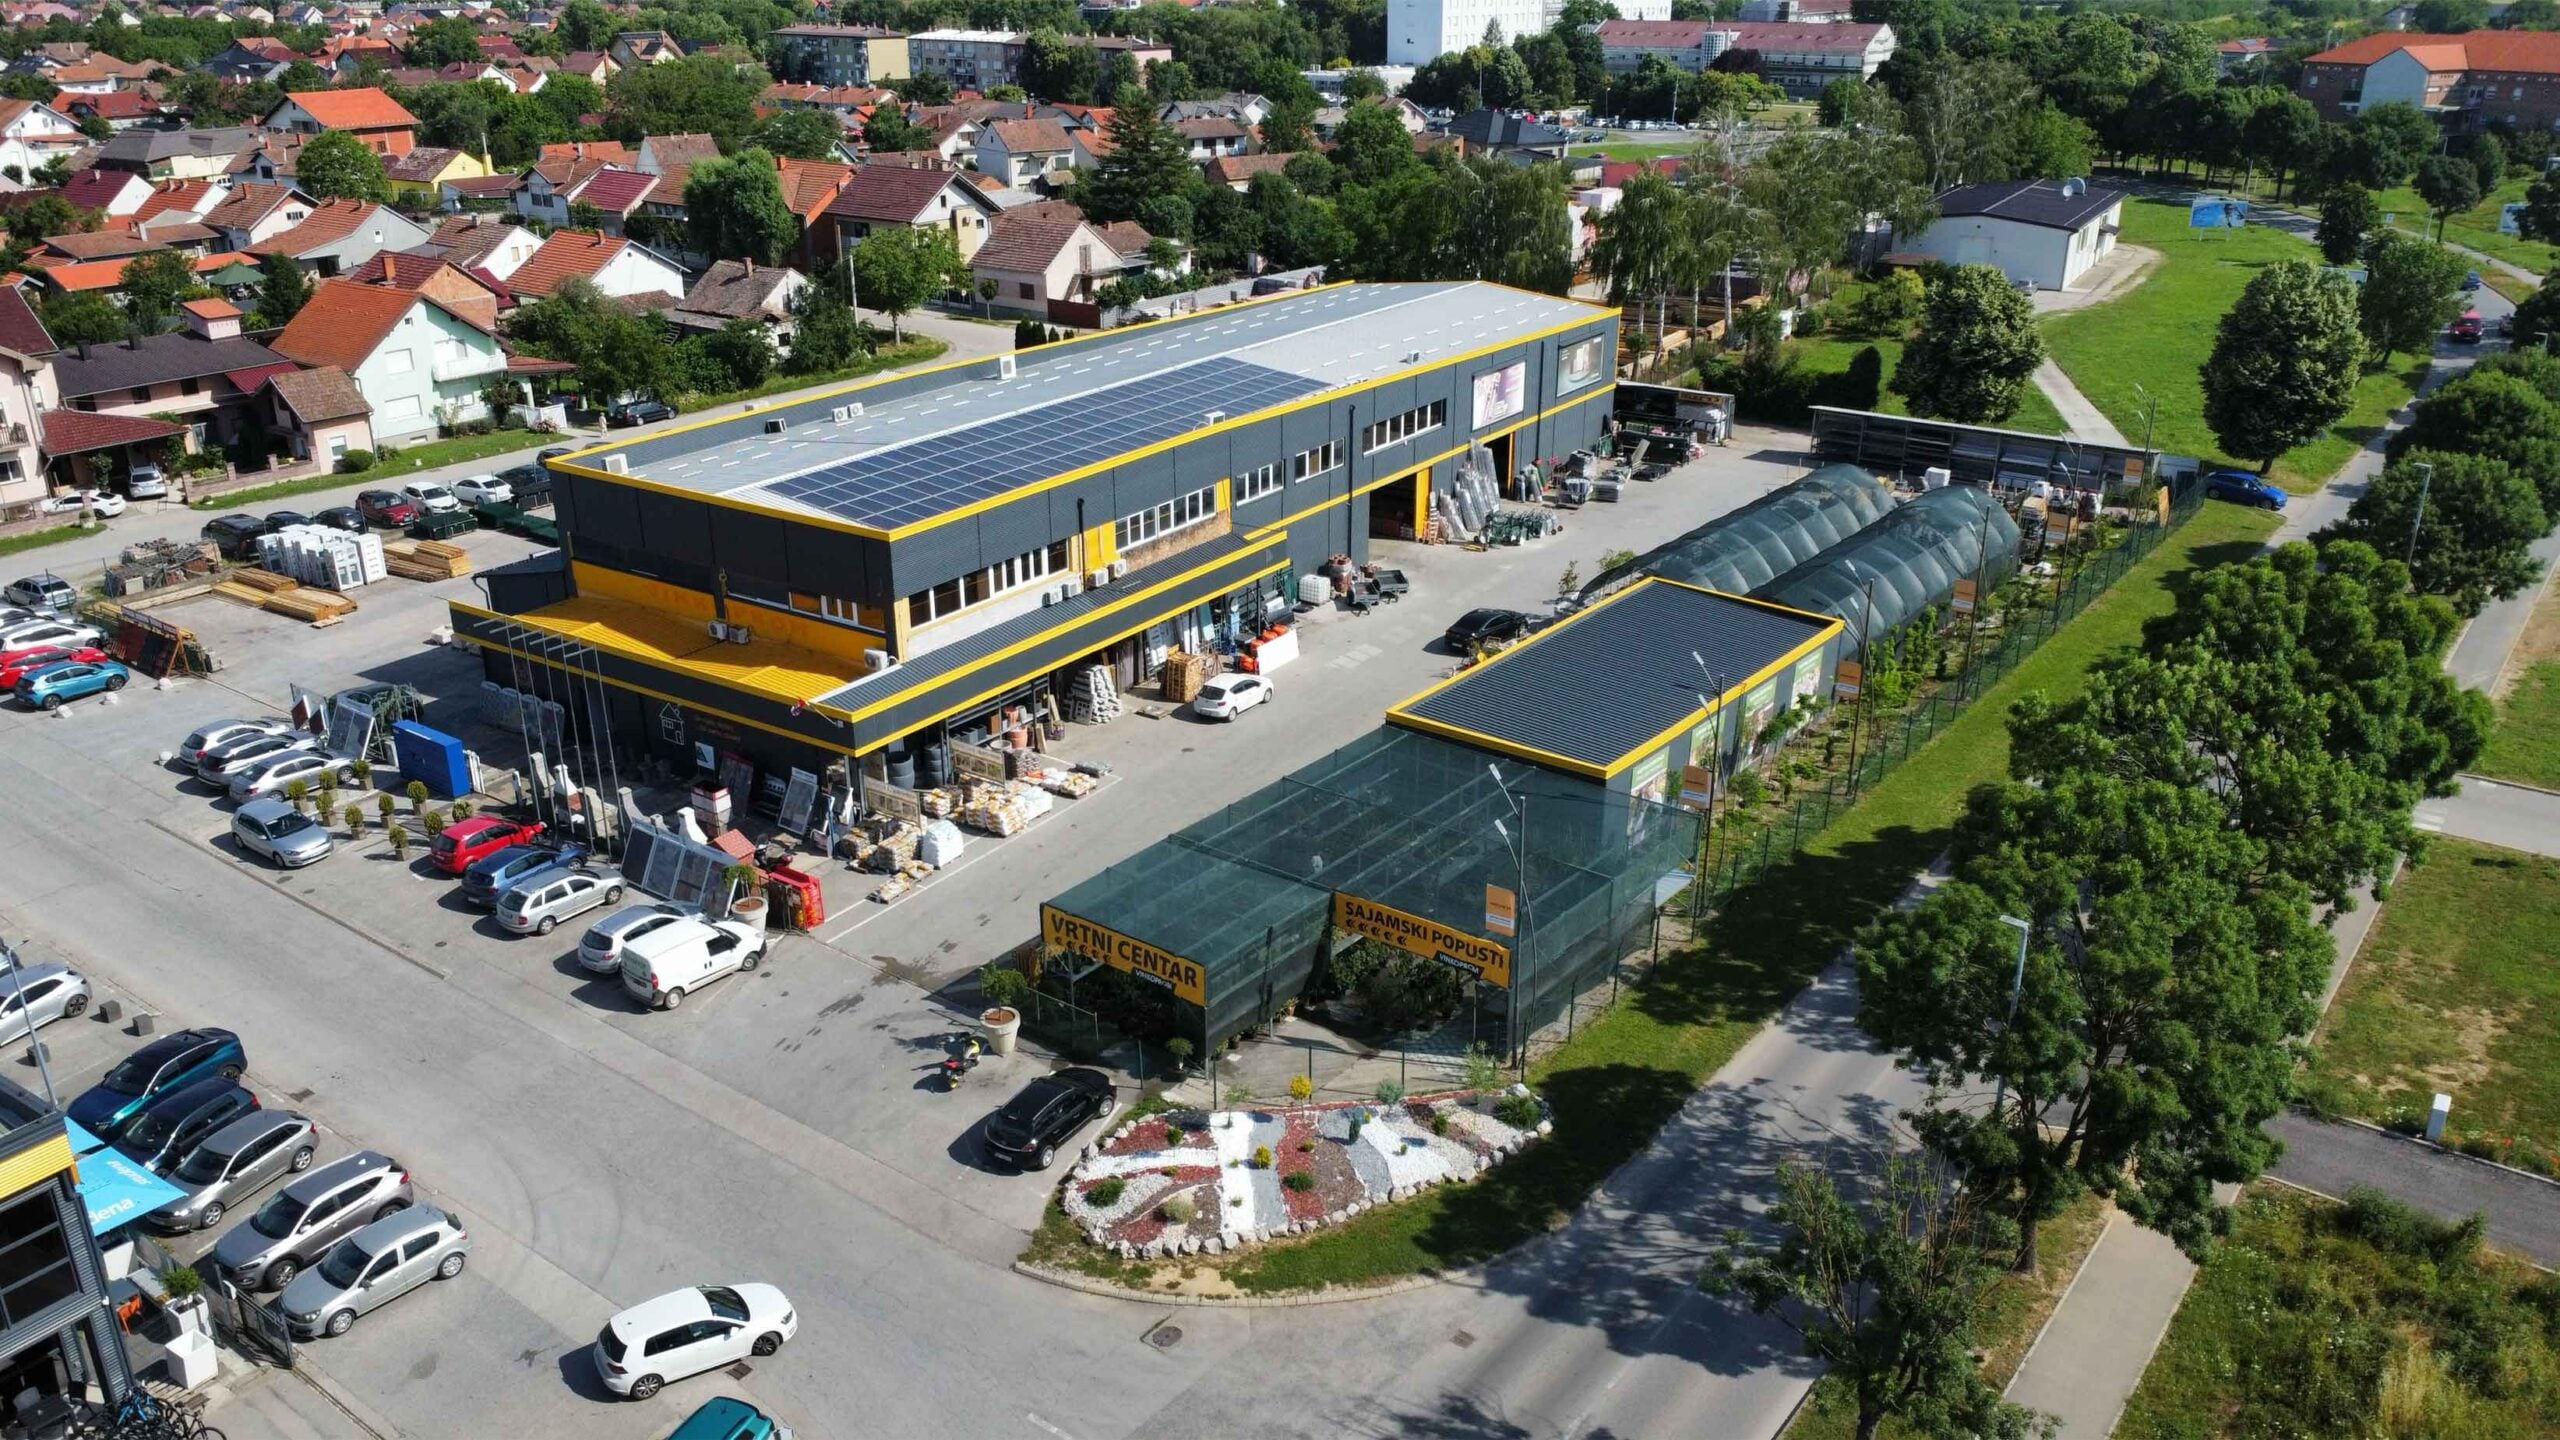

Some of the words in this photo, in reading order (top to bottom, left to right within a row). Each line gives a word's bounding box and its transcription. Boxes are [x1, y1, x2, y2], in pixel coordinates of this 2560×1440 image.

[1051, 913, 1113, 954] VRTNI
[1117, 940, 1198, 989] CENTAR
[1345, 901, 1428, 941] SAJAMSKI
[1431, 930, 1504, 969] POPUSTI
